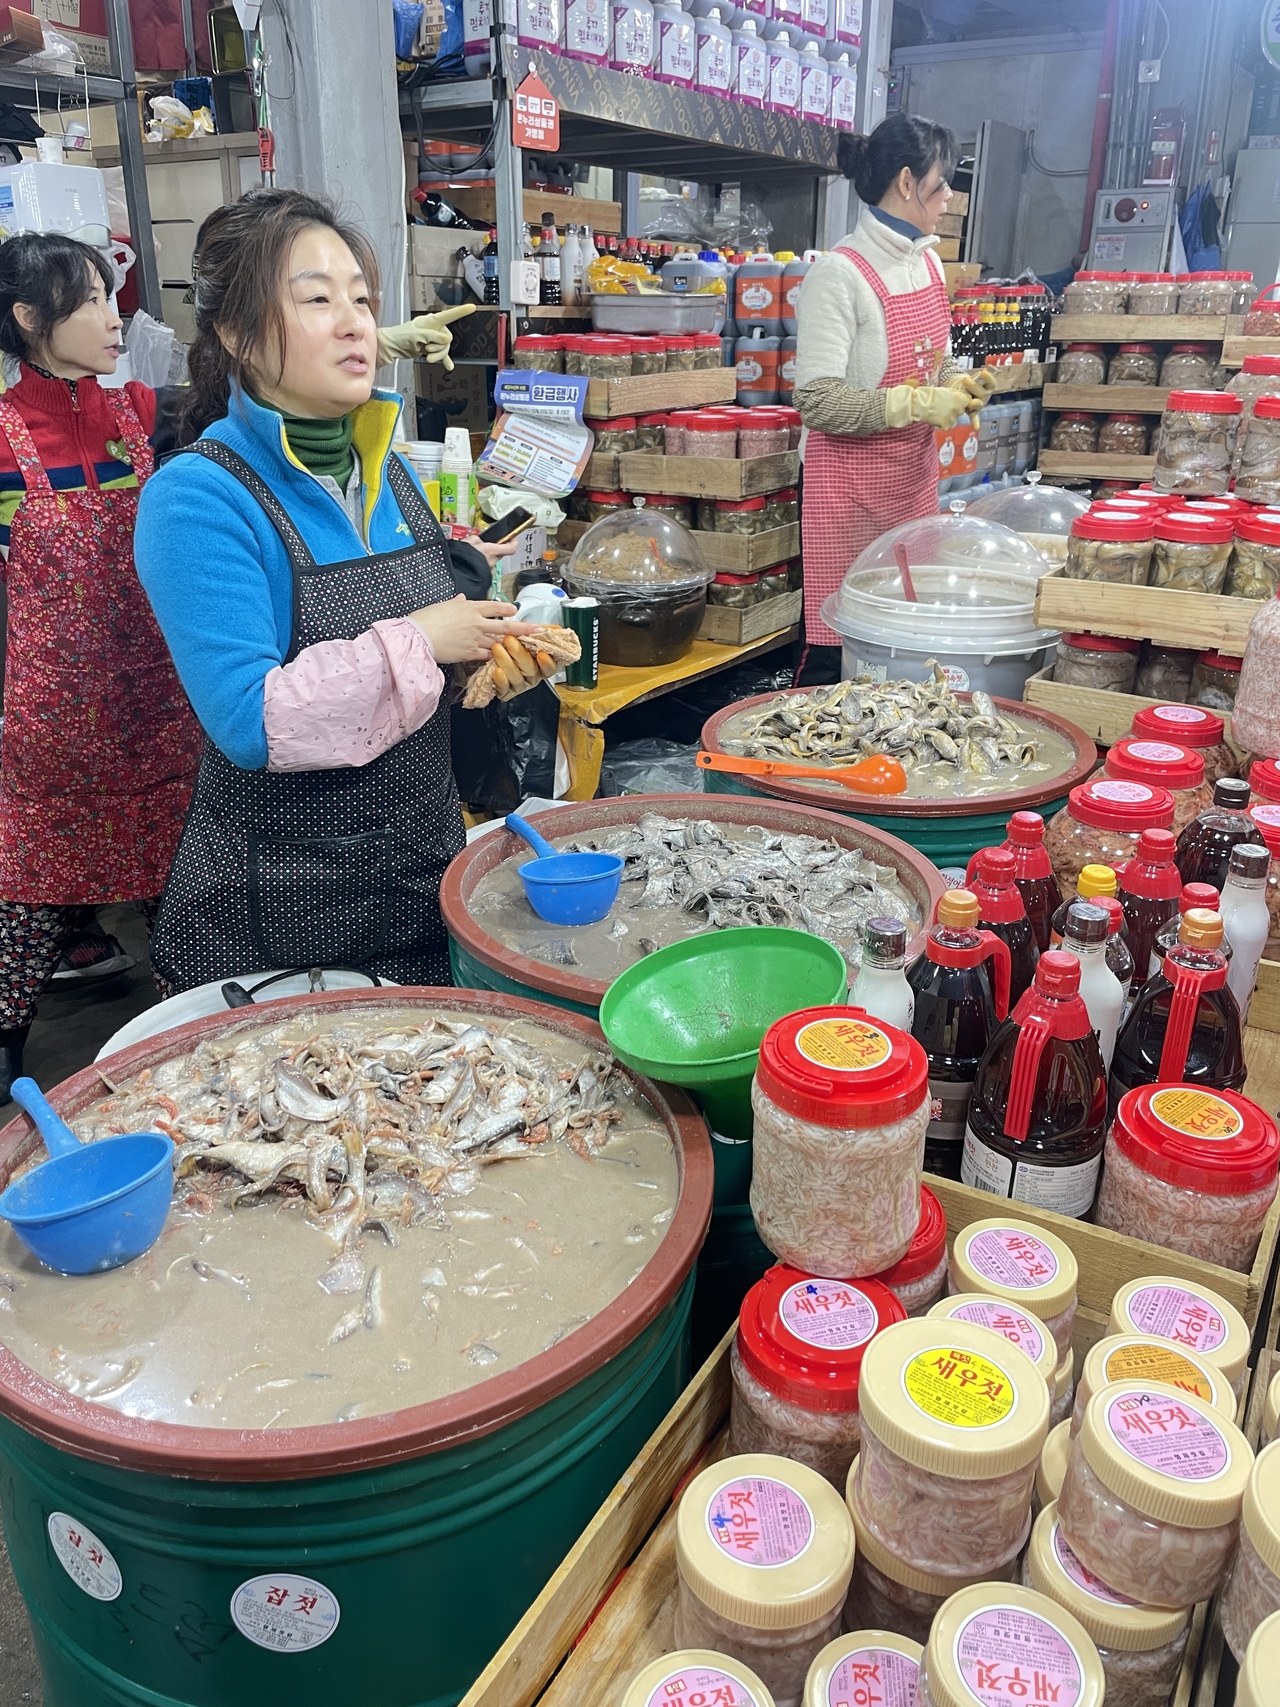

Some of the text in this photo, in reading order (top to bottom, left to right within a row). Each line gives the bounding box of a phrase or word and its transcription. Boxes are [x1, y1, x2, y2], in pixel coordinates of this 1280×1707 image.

[517, 113, 555, 130] 온누리상품권
[525, 127, 545, 140] 가맹점
[533, 386, 579, 403] 환급행사
[833, 1024, 880, 1058] 새우젓
[1184, 1106, 1230, 1133] 새우젓
[1004, 1235, 1048, 1278] 새우젓
[794, 1291, 856, 1315] 새우젓
[989, 1313, 1024, 1346] 새우
[1171, 1303, 1207, 1349] 새우젓
[930, 1356, 1004, 1402] 새우젓
[1122, 1407, 1196, 1435] 새우젓
[728, 1490, 760, 1551] 새우젓
[67, 1528, 104, 1568] 잡젓
[265, 1585, 318, 1615] 잡젓
[852, 1663, 883, 1706] 우젓
[976, 1659, 1061, 1702] 새우젓
